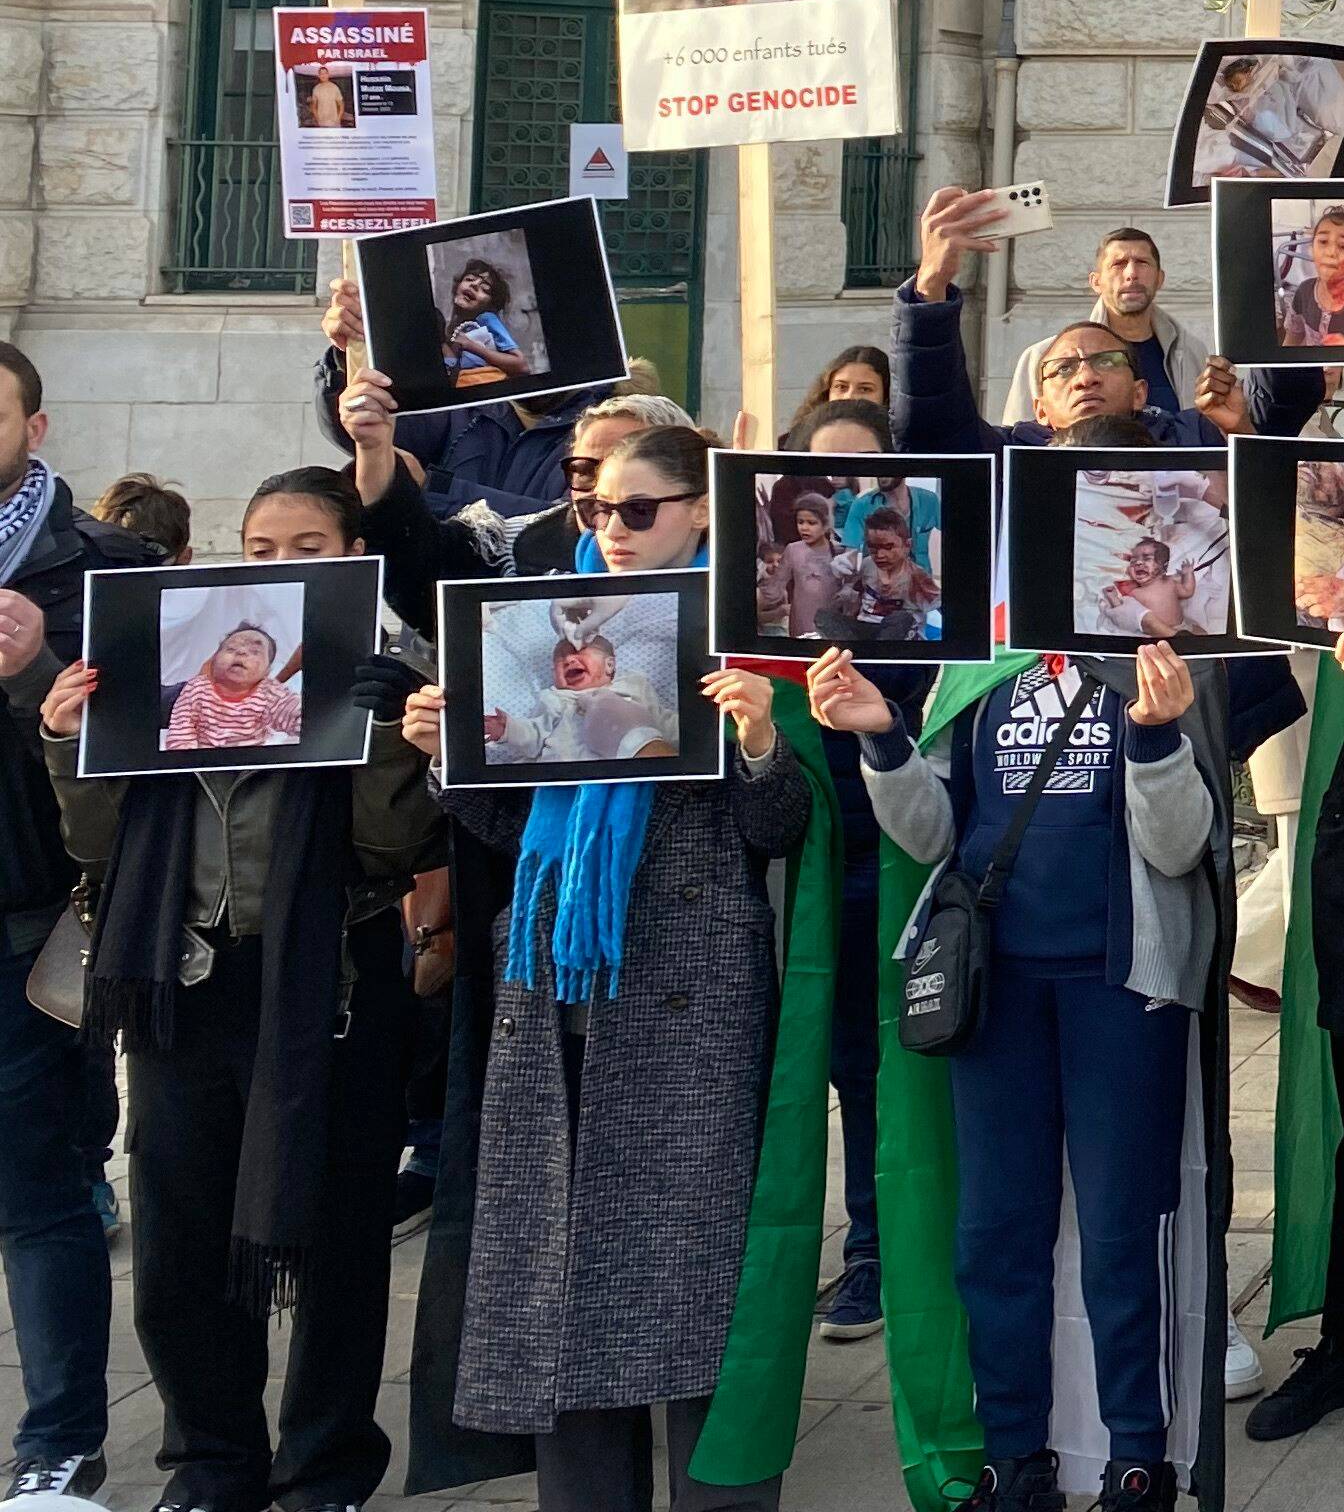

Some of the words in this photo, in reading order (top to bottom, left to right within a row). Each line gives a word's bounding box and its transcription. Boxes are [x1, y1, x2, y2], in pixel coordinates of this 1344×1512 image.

[290, 23, 414, 44] ASSASSINÉ
[317, 49, 341, 58] PAR
[344, 48, 388, 58] ISRAEL
[664, 46, 685, 66] +6
[690, 47, 728, 65] 000
[733, 37, 802, 62] enfants
[808, 37, 847, 56] tués
[658, 95, 719, 118] STOP
[727, 85, 857, 113] GENOCIDE
[1068, 753, 1109, 766] SPORT
